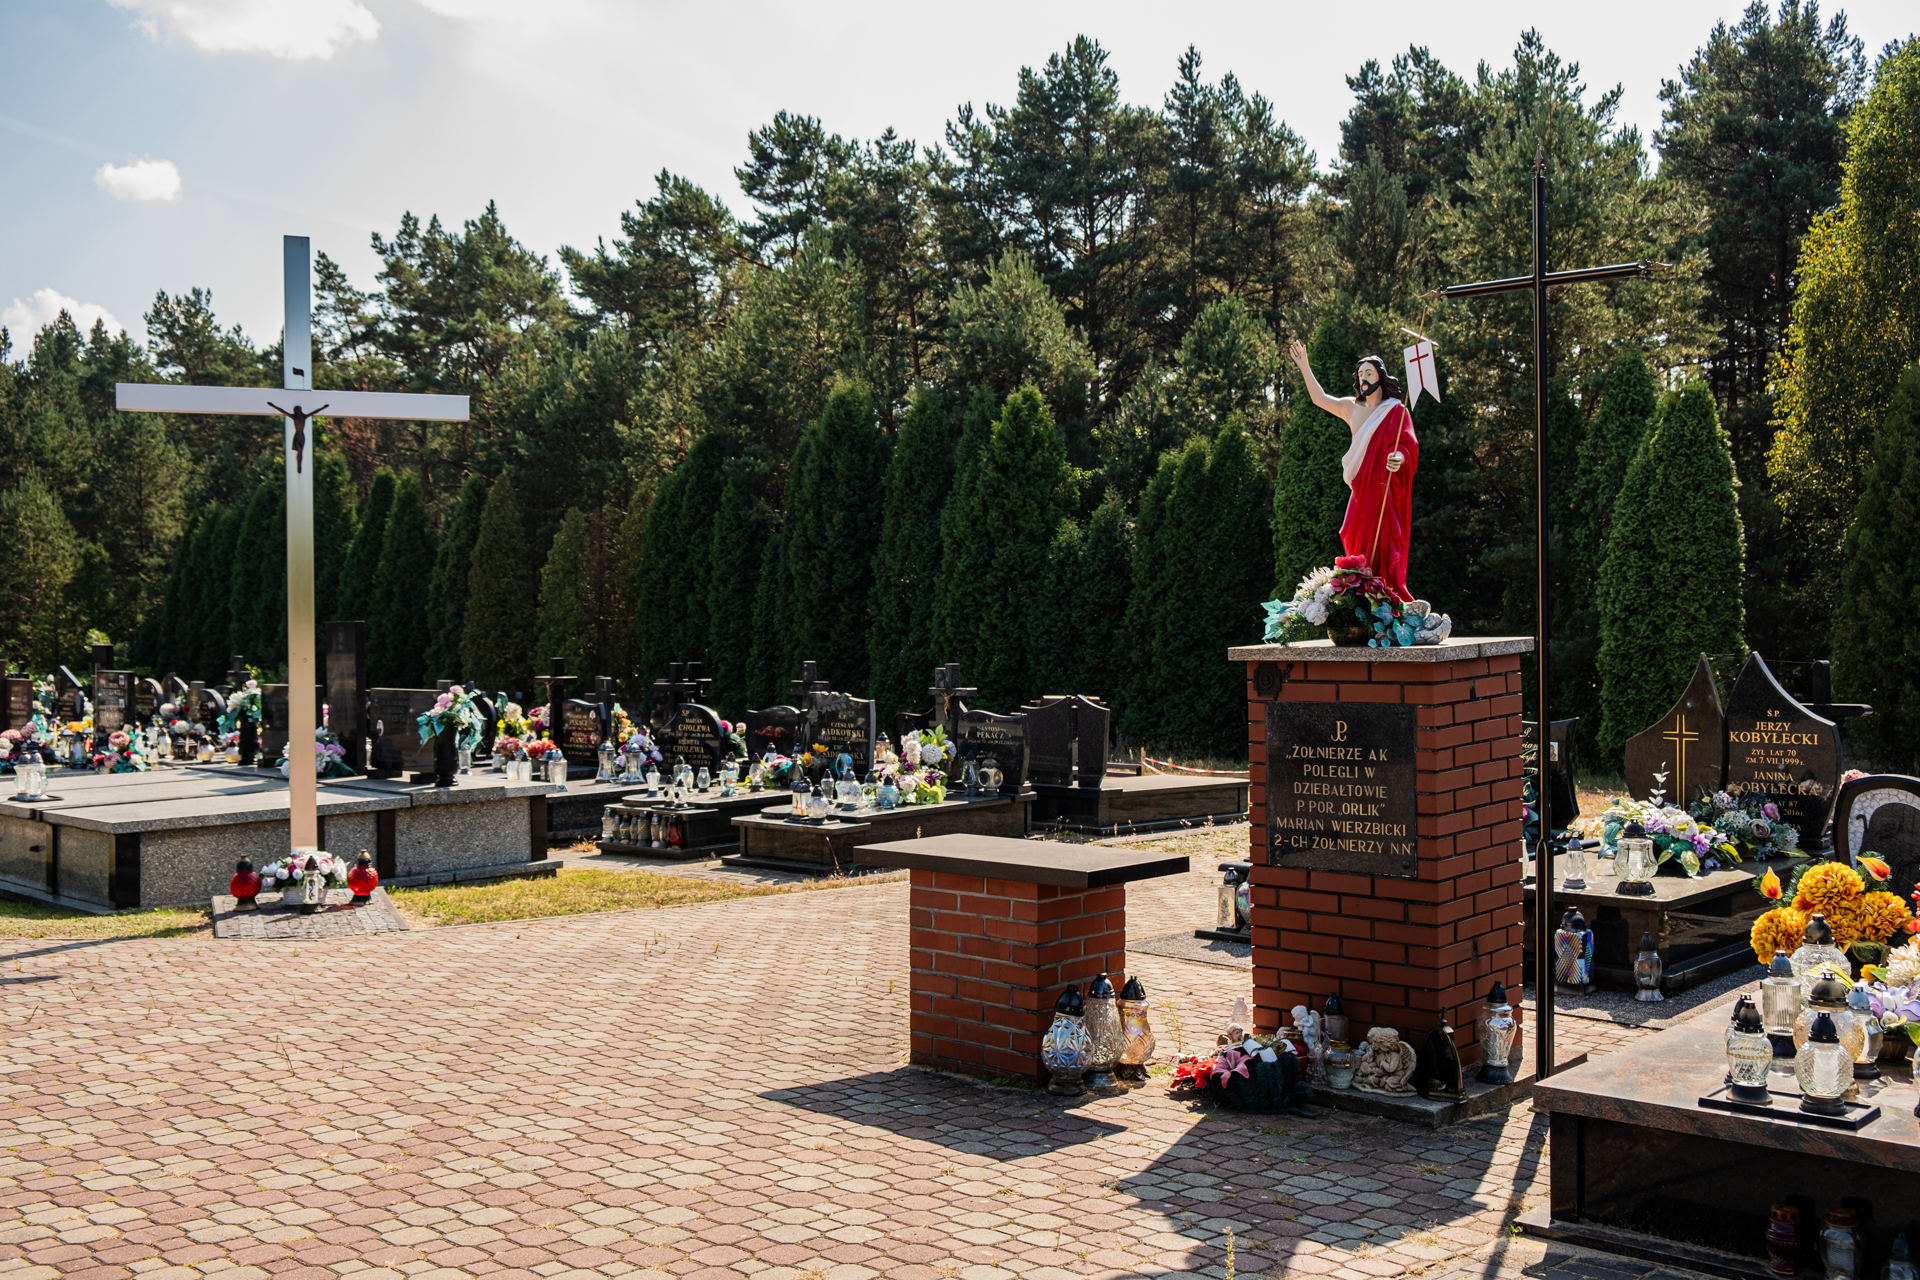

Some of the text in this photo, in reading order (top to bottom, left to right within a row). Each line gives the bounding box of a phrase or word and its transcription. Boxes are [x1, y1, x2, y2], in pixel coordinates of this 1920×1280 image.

[678, 724, 711, 732] CHOLEWA
[1755, 721, 1791, 731] JERZY
[821, 728, 865, 738] SADKOWSKI
[1729, 731, 1819, 745] KOBYŁECKI
[673, 745, 704, 754] CHOLEWA
[1770, 749, 1784, 757] LAT
[1786, 749, 1797, 757] 70
[1303, 764, 1376, 779] POLEGLI W
[1753, 770, 1794, 782] JANINA
[1293, 781, 1388, 799] DZIEBAŁTOWIE
[1788, 800, 1798, 808] 87
[1276, 816, 1406, 837] MARIAN WIERZBICKI
[1274, 833, 1308, 848] 2-CH
[1312, 834, 1385, 854] ŻOŁNIERZY
